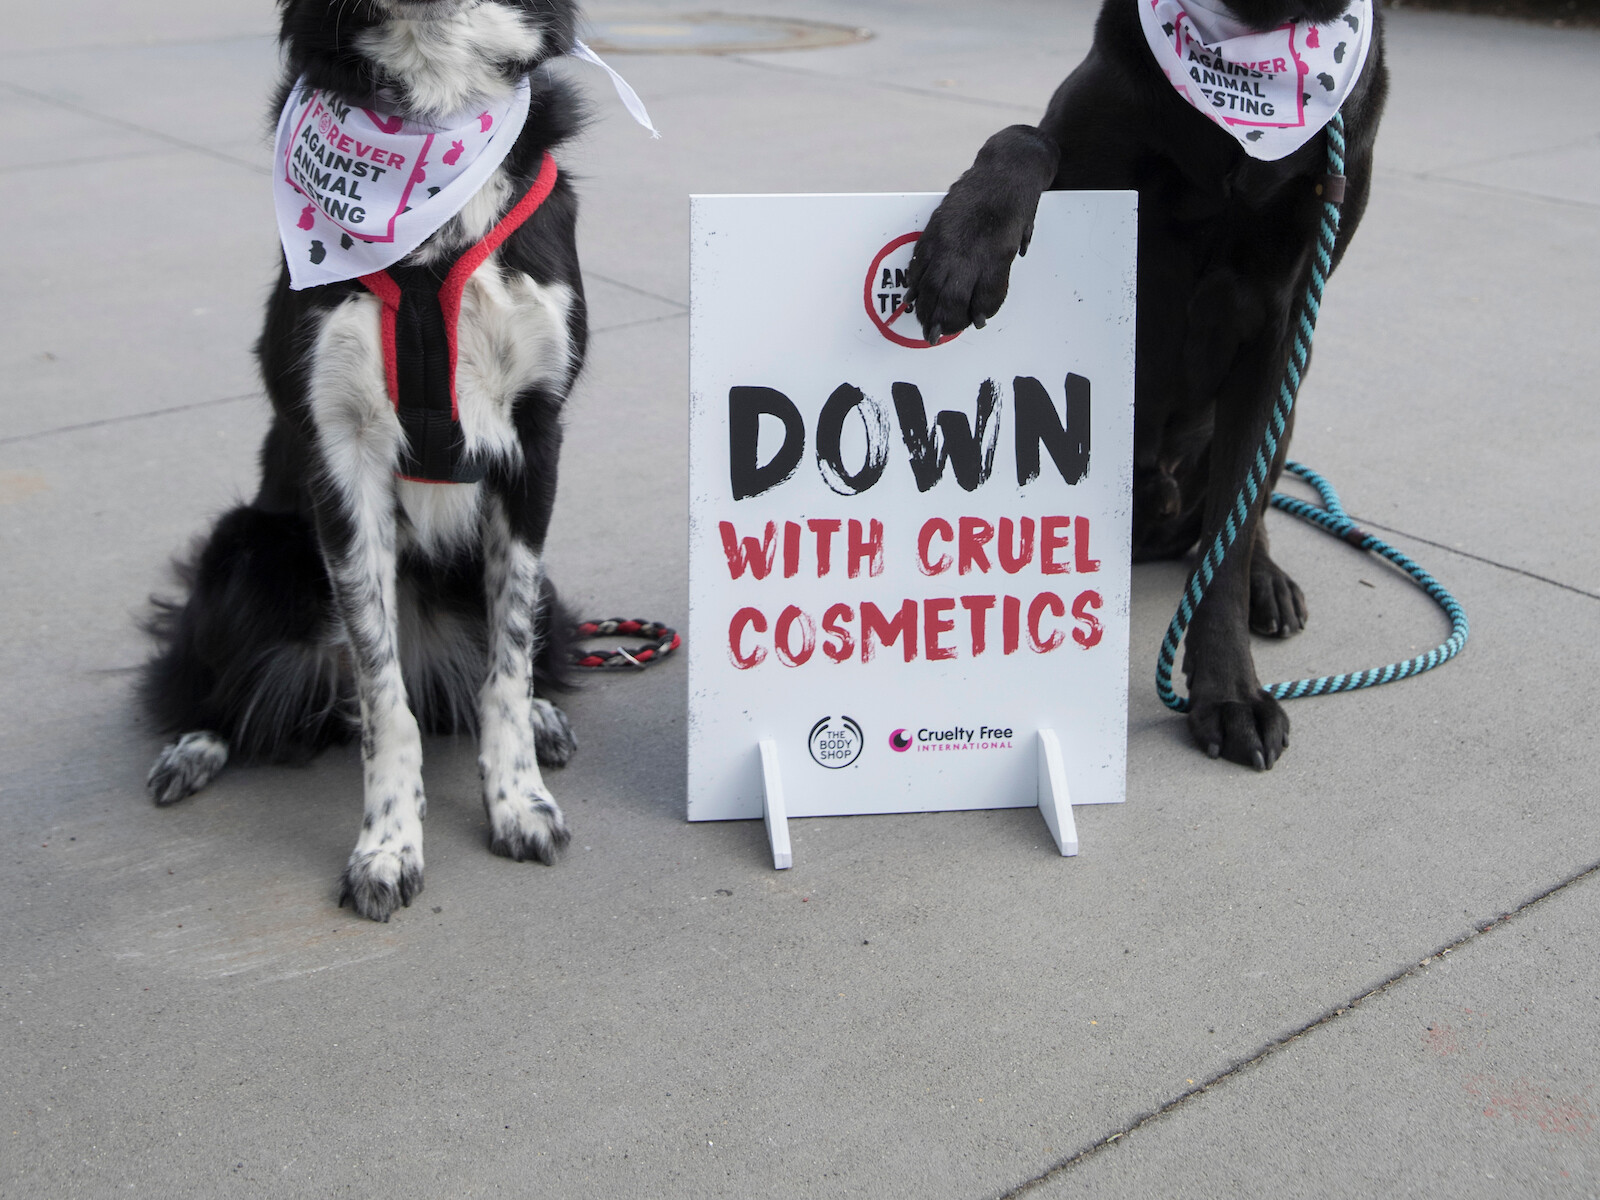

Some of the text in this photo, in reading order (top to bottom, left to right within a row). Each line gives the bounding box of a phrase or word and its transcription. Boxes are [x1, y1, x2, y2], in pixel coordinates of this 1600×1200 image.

[1189, 66, 1266, 98] ANIMAL
[1200, 88, 1275, 117] STING
[301, 124, 386, 183] AGAINST
[293, 144, 363, 201] ANIMAL
[292, 162, 366, 224] TESTING
[728, 372, 1091, 501] DOWN
[718, 515, 1101, 580] WITH CRUEL
[728, 589, 1104, 670] COSMETICS
[819, 739, 853, 750] BODY
[826, 730, 846, 739] THE
[917, 726, 1013, 743] Cruelty Free
[917, 742, 1013, 752] INTERNATIONAL
[820, 750, 852, 760] SHOP
